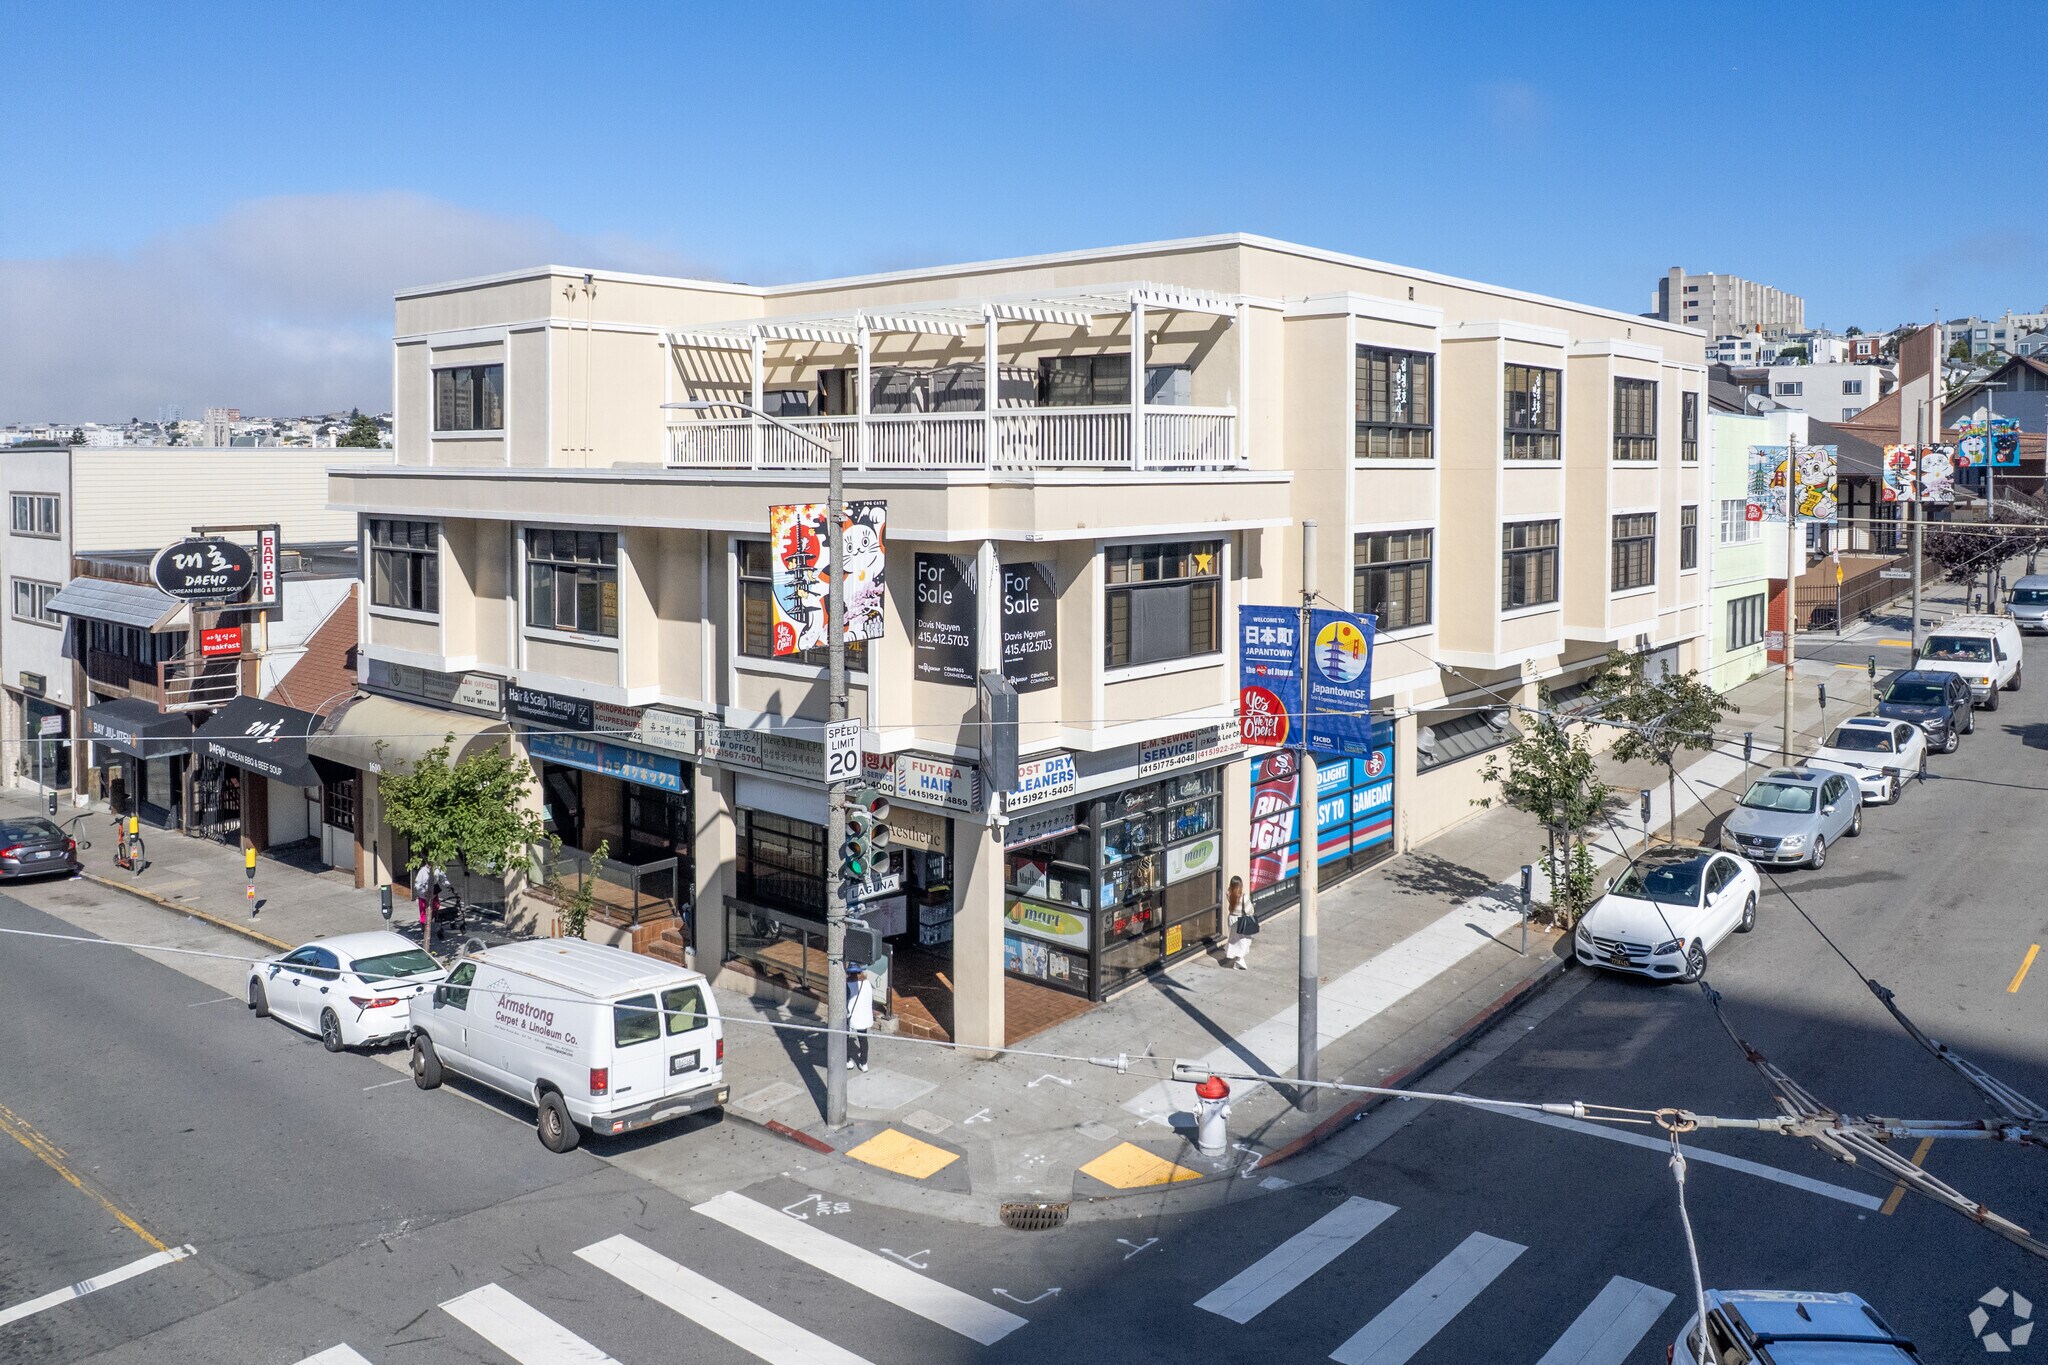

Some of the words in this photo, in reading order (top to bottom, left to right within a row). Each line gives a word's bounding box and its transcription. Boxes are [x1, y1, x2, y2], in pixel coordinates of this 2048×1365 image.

[184, 575, 228, 587] DAEHO
[918, 562, 945, 582] For
[1004, 573, 1031, 592] For
[918, 583, 953, 605] Sale
[1004, 593, 1039, 615] Sale
[777, 624, 789, 639] Yes
[918, 619, 935, 629] Davis
[935, 621, 961, 633] Nguyen
[1004, 632, 1023, 641] Davis
[1023, 629, 1046, 641] Nguyen
[918, 632, 970, 647] 415.412.5703
[1245, 625, 1294, 646] 日本町
[203, 642, 240, 651] Breakfast
[1004, 639, 1053, 656] 415.412.5703
[1245, 647, 1293, 657] JAPANTOWN
[943, 665, 965, 674] COMPASS
[943, 672, 974, 680] COMMERCIAL
[1245, 666, 1256, 674] the
[1267, 667, 1274, 676] of
[1274, 667, 1294, 677] Jtown
[474, 680, 497, 691] OFFICES
[463, 695, 476, 703] YUJI
[476, 698, 497, 707] MITANI
[509, 688, 523, 702] Hair
[523, 691, 529, 703] &
[529, 692, 548, 710] Scalp
[547, 696, 577, 716] Therapy
[594, 702, 641, 718] CHIROPRACTIC
[1245, 691, 1271, 717] Yes
[93, 722, 105, 735] BAY
[594, 714, 641, 729] ACUPRESSURE
[1243, 716, 1279, 742] Open!
[763, 733, 781, 746] Steve
[828, 725, 859, 739] SPEED
[1160, 730, 1196, 745] SEWING
[709, 738, 726, 748] LAW
[729, 743, 757, 754] OFFICE
[831, 737, 855, 750] LIMIT
[1144, 741, 1194, 763] SERVICE
[226, 749, 244, 763] KOREAN
[258, 760, 269, 772] BEEF
[269, 763, 283, 776] SOUP
[830, 750, 857, 776] 20
[861, 751, 894, 773] 행사
[912, 761, 962, 780] FUTABA
[1018, 764, 1040, 777] OST
[1045, 756, 1073, 774] DRY
[1140, 753, 1196, 774] (415)775-4048
[867, 772, 894, 783] SERVICE
[1323, 765, 1347, 783] LIGHT
[920, 775, 953, 793] HAIR
[908, 788, 968, 807] (415)921-4859
[1007, 784, 1074, 808] (415)921-5405
[1353, 782, 1393, 814] GAMEDAY
[1254, 795, 1289, 828] BUD
[1332, 798, 1345, 820] TO
[888, 820, 941, 847] Aesthetic
[1184, 846, 1208, 863] mart
[1019, 870, 1045, 888] Marlboro
[851, 879, 895, 899] LAGUNA
[1024, 907, 1061, 928] mart
[497, 993, 555, 1026] Armstrong
[495, 1010, 519, 1026] Carpet
[521, 1019, 526, 1029] &
[529, 1021, 562, 1040] Linoleum
[564, 1032, 578, 1045] Co.
